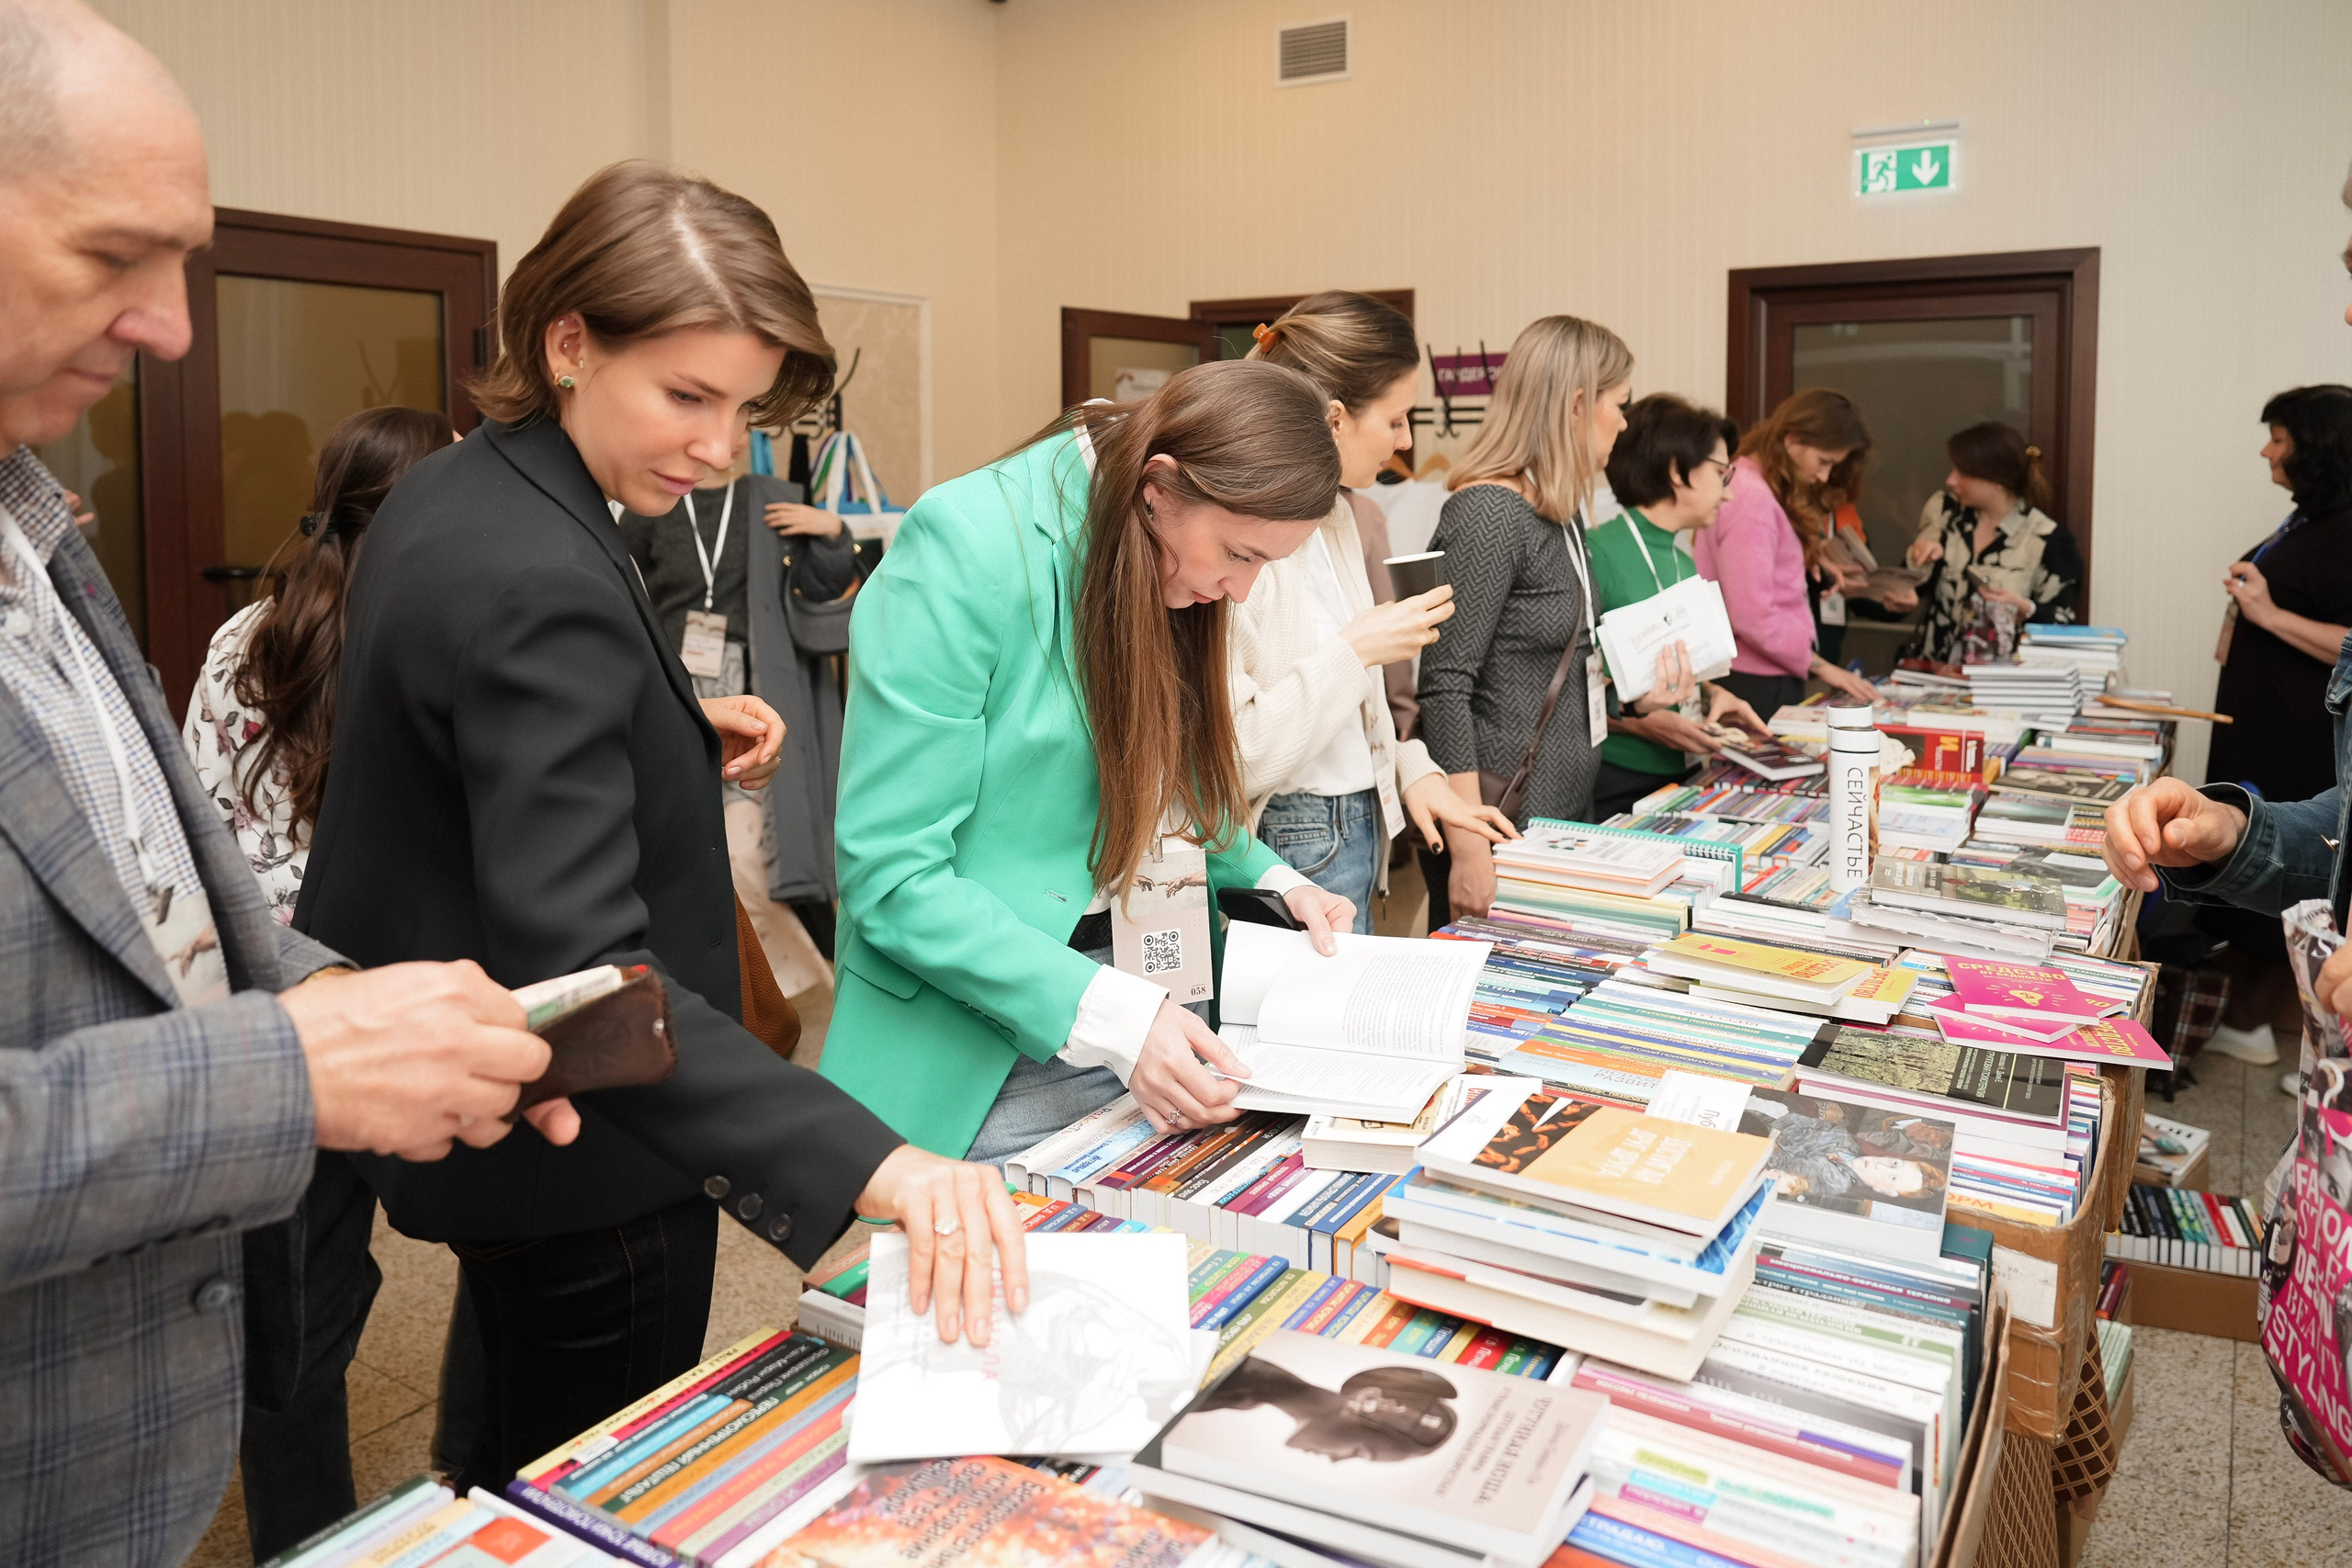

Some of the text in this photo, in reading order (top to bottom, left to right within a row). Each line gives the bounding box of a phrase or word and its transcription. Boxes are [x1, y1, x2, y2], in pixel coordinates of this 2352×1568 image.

[1847, 766, 1868, 878] СЕЙЧАСТЬЕ
[1798, 959, 1842, 980] СРЕДСТВО
[1957, 962, 2067, 981] СРЕДСТВО
[1993, 971, 2053, 983] БЕДНОСТИ
[1191, 985, 1207, 998] 058
[1492, 985, 1516, 994] ТЕЛА
[1635, 1007, 1683, 1021] ГРУППОВАЯ
[1685, 1016, 1760, 1035] ПСИХОТЕРАПИЯ
[1683, 1009, 1758, 1027] АГРЕССИЯ
[1606, 1062, 1655, 1076] ДЕТСТВО
[1619, 1043, 1724, 1067] ДЕТСКИЙ ПСИХОАНАЛИЗ
[1767, 1258, 1905, 1293] ЭМОЦИОНАЛЬНО-ОБРАЗНАЯ
[1905, 1288, 1952, 1304] ТЕРАПИЯ
[756, 1339, 809, 1380] Жан-Мари
[778, 1343, 831, 1382] Фредерик
[725, 1371, 762, 1400] Робин
[746, 1374, 783, 1403] Перлз
[675, 1393, 780, 1466] ПЕРЕСМОТРЕННЫЙ
[617, 1458, 681, 1505] ГЕШТАЛЬТ
